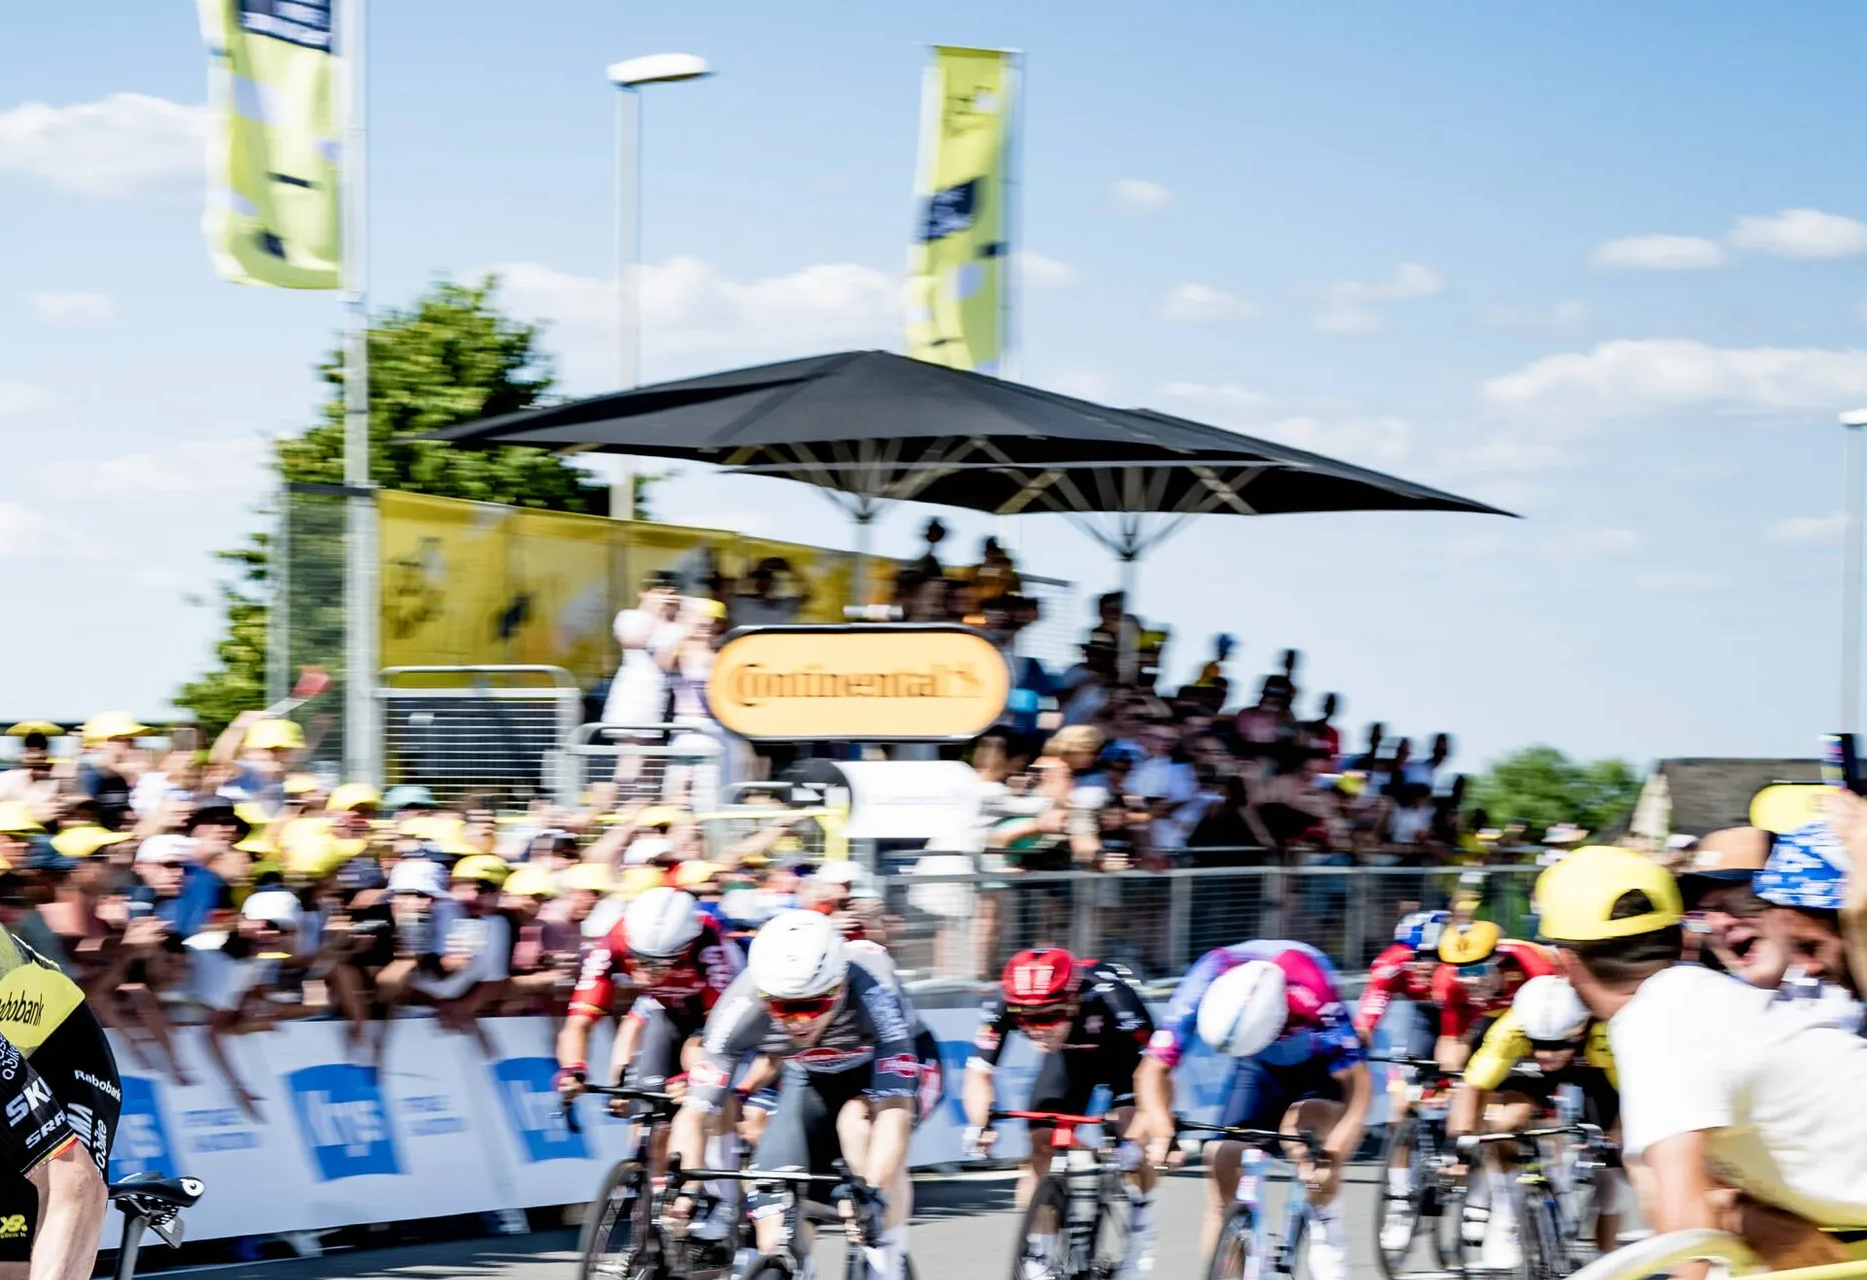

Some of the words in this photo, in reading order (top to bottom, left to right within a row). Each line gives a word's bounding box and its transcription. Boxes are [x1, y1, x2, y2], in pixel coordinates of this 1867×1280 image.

[729, 662, 948, 706] Continental
[74, 1069, 121, 1102] Rabobank
[25, 1109, 67, 1149] SRA
